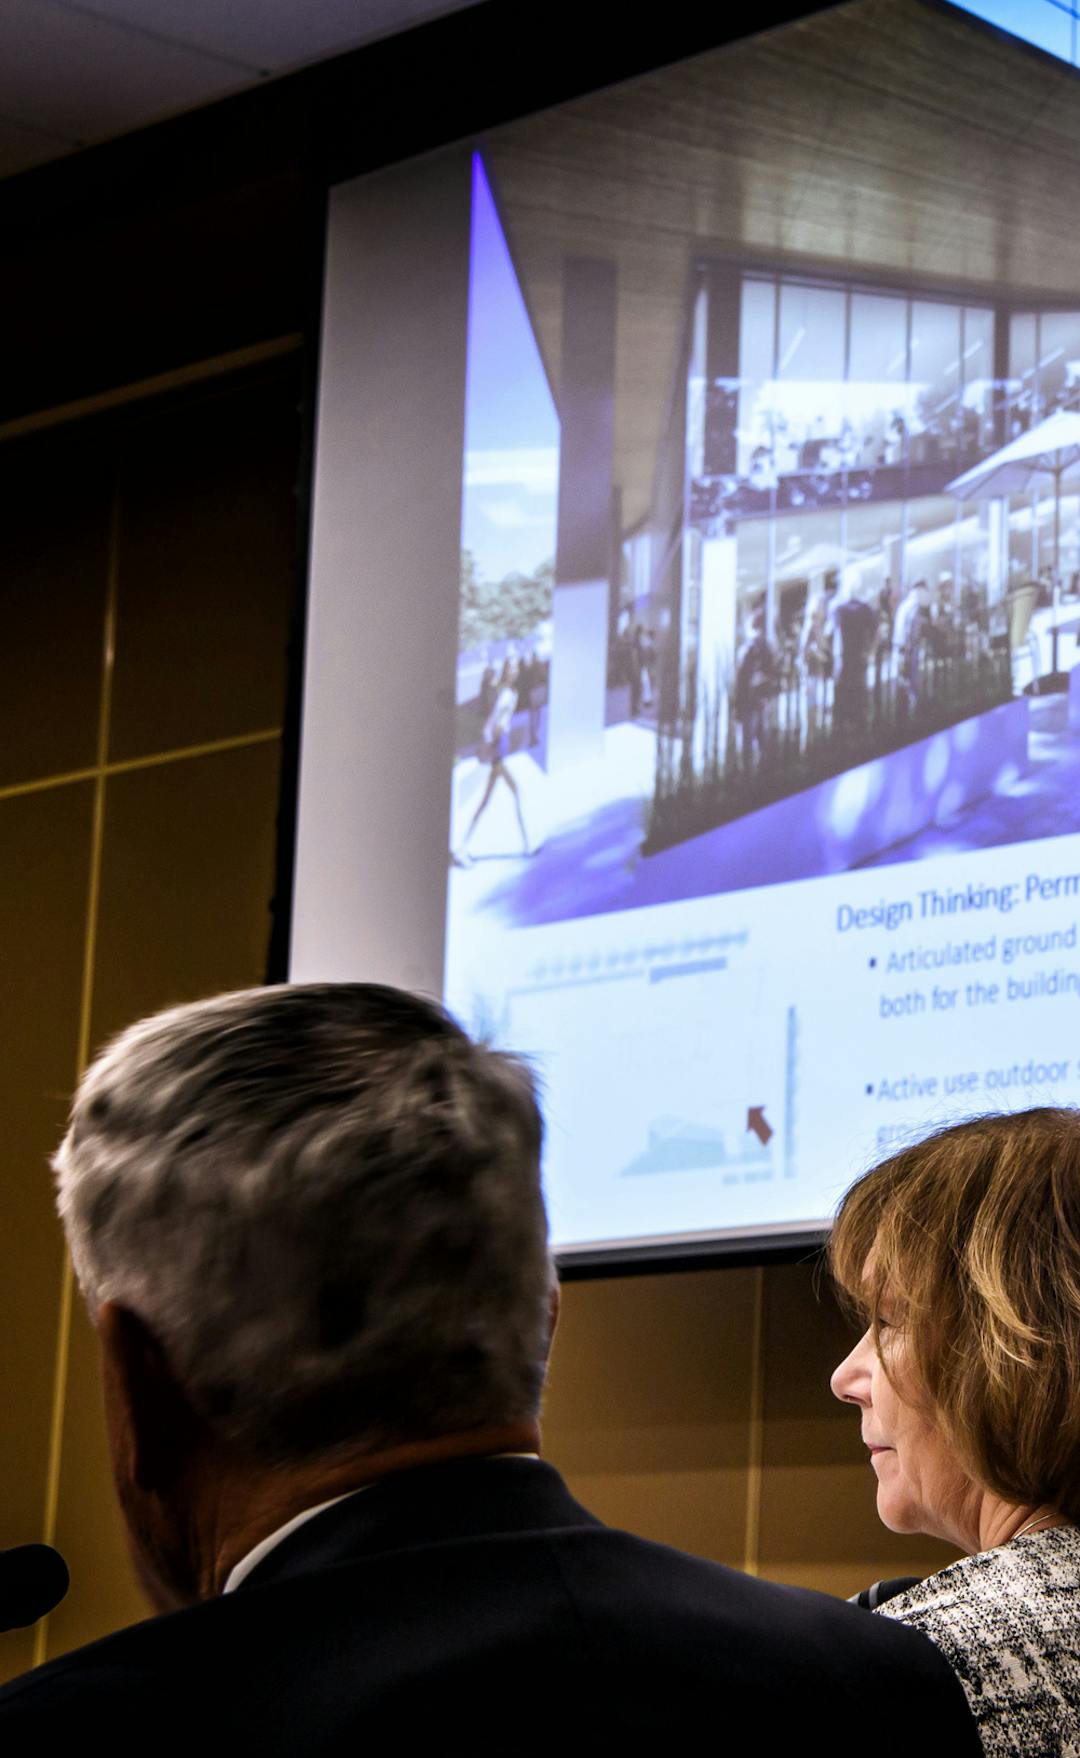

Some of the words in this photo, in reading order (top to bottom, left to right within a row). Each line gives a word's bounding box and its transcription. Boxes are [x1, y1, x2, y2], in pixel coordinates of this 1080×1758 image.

[837, 898, 912, 932] Design
[919, 881, 1020, 918] Thinking:
[885, 937, 997, 974] Articulated
[1002, 923, 1077, 963] ground
[880, 990, 925, 1018] both
[932, 984, 958, 1011] for
[966, 979, 999, 1006] the
[877, 1073, 938, 1103] Active
[944, 1072, 977, 1095] use
[986, 1057, 1069, 1090] outdoor
